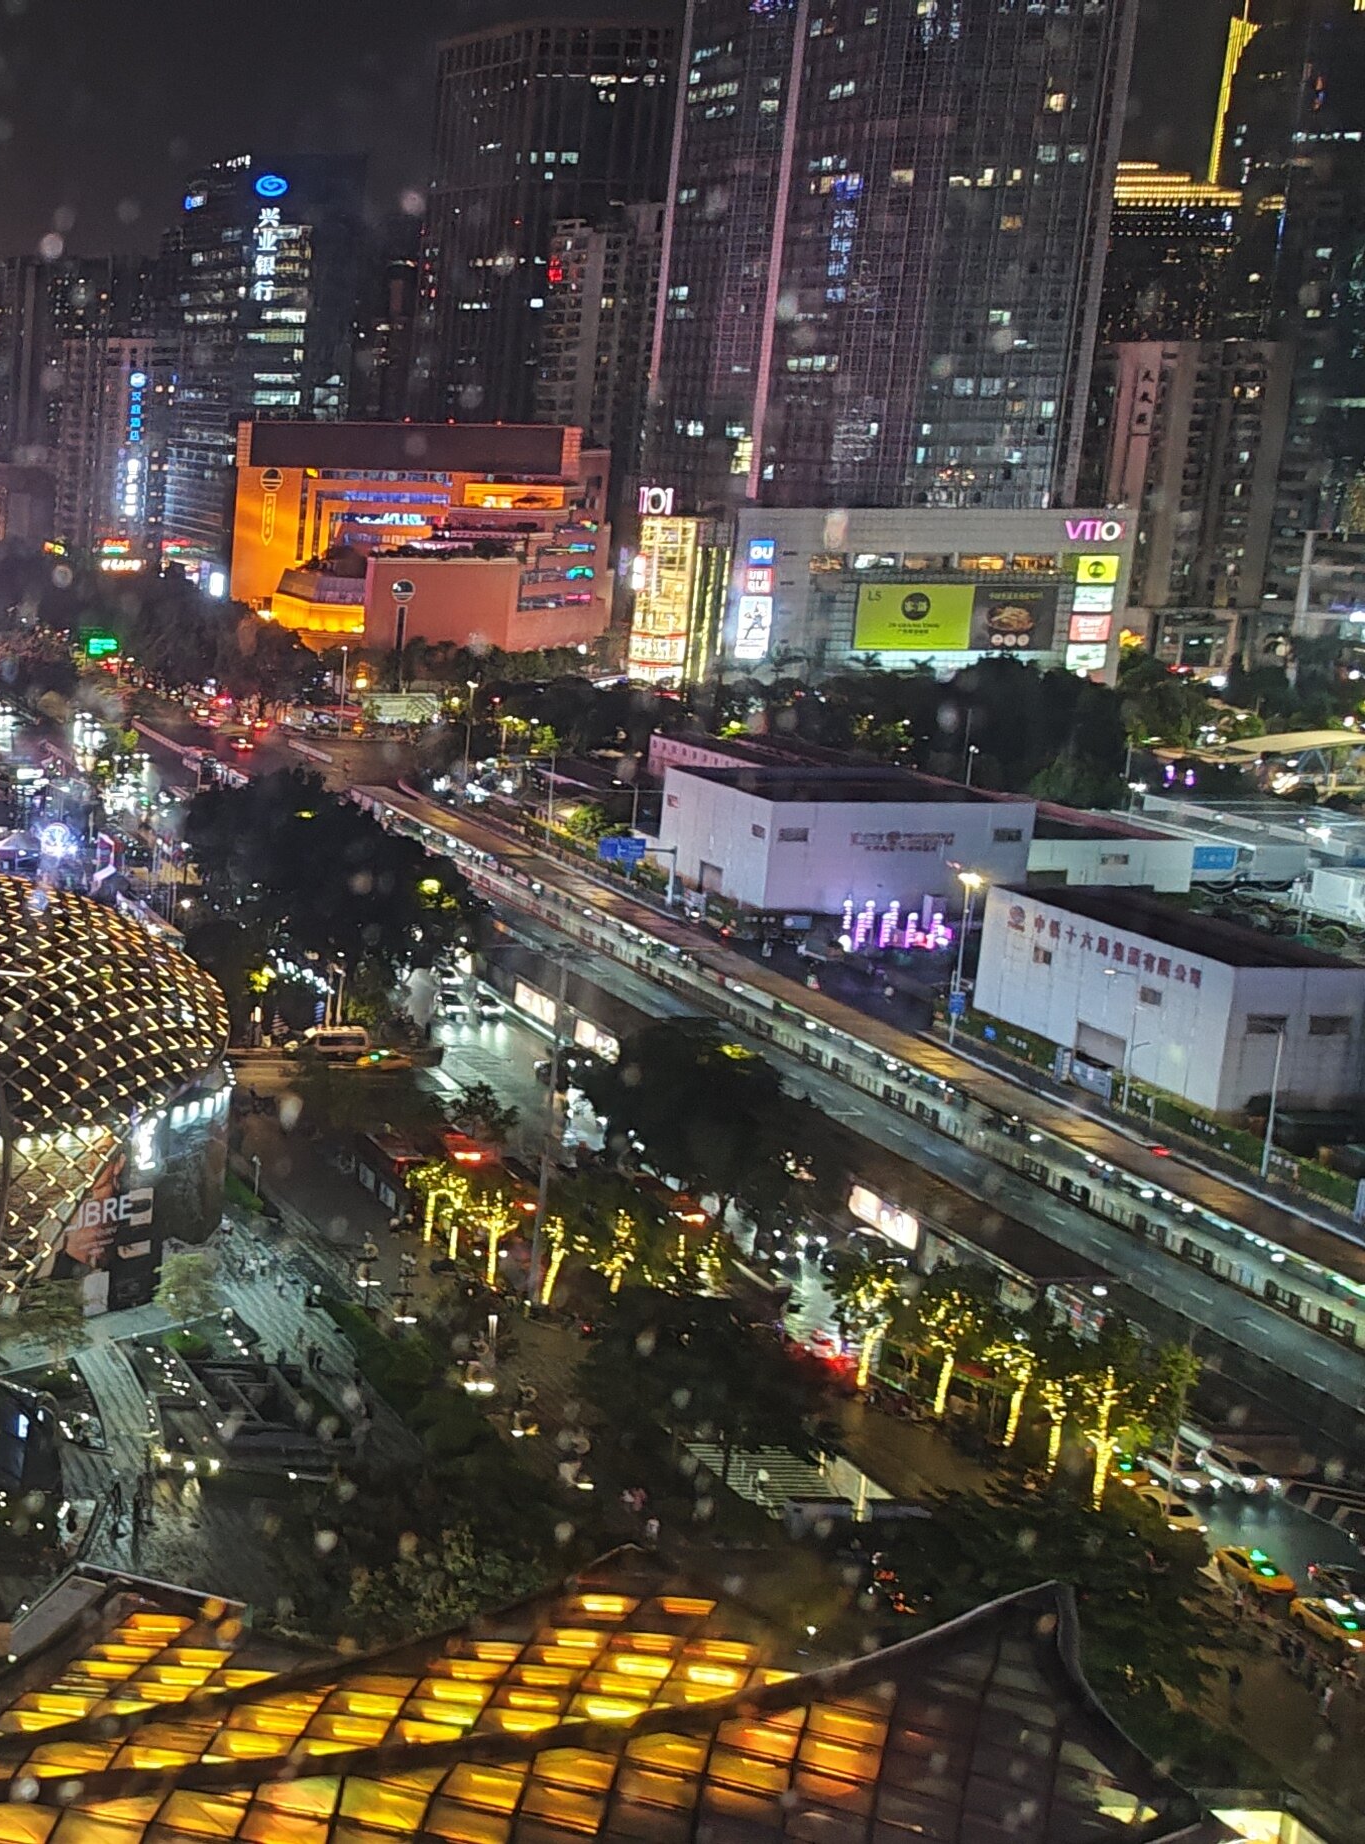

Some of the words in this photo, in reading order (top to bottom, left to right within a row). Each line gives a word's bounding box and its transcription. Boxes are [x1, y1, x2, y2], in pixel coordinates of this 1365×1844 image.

[254, 206, 281, 301] 兴业银行
[750, 545, 774, 560] GU
